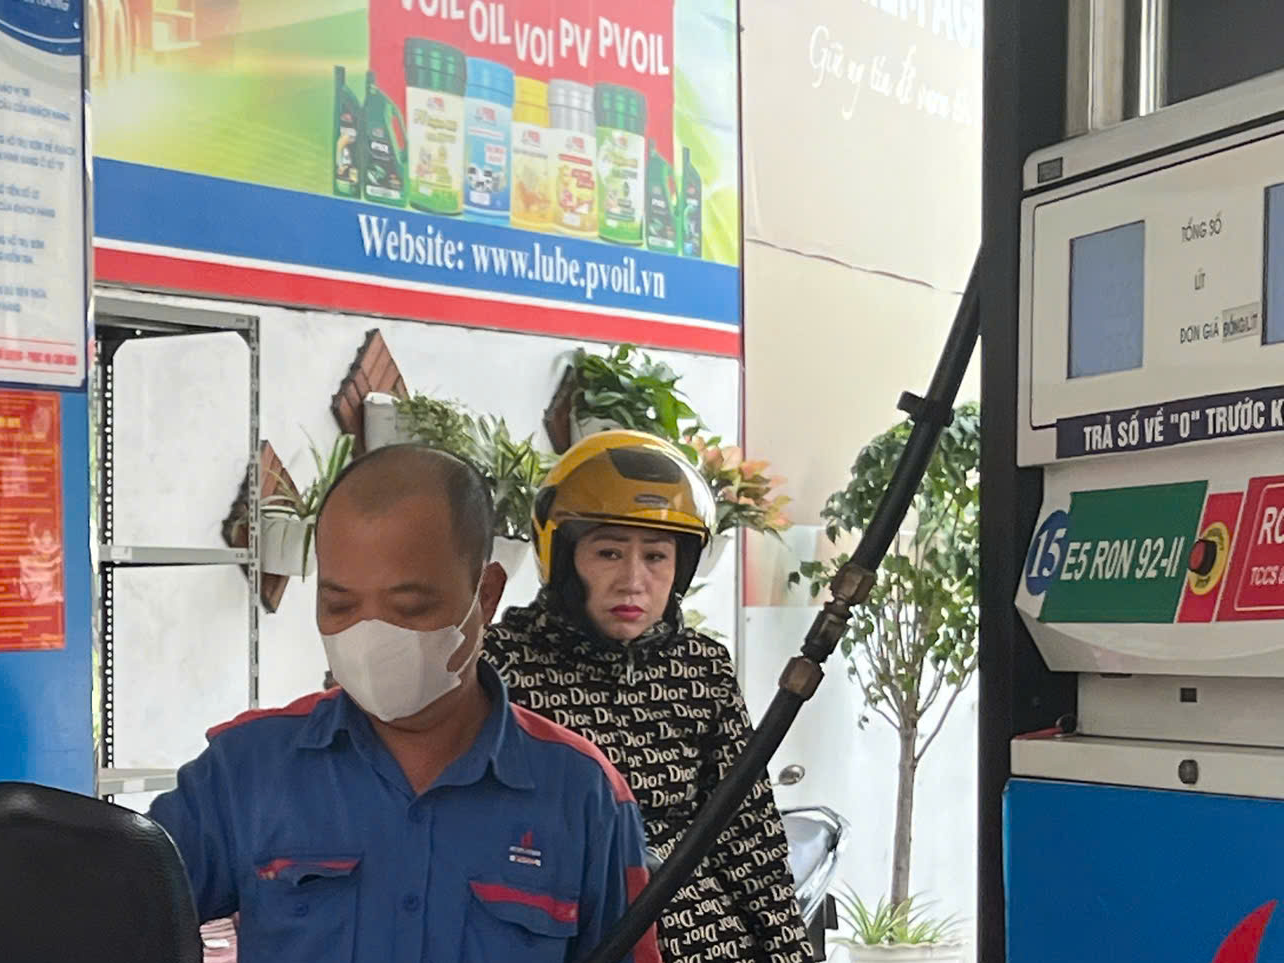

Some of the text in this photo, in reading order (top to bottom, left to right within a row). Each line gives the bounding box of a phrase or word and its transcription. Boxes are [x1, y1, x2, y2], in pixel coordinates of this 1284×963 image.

[469, 0, 512, 44] OIL
[514, 20, 554, 67] VOI
[559, 17, 591, 68] PV
[597, 16, 670, 75] PVOIL
[357, 213, 666, 299] Website: www.lube.pvoil.vn
[1202, 316, 1220, 340] GIÁ
[1083, 415, 1113, 452] TRẢ
[1117, 409, 1140, 448] SỐ
[1144, 407, 1165, 443] VỀ
[1205, 397, 1266, 435] TRƯỚC
[1027, 528, 1068, 579] 15
[1060, 541, 1087, 581] E5
[1089, 538, 1136, 580] RON
[688, 639, 725, 657] Dior
[508, 668, 584, 688] Dior Dior
[670, 659, 708, 679] Dior
[529, 690, 567, 709] Dior
[569, 687, 610, 705] Dior
[650, 683, 688, 701] Dior
[554, 703, 712, 727] Dior Dior Dior Dior
[581, 728, 619, 745] Dior
[619, 729, 655, 746] Dior
[642, 747, 680, 764] Dior
[630, 770, 667, 789] Dior
[651, 789, 685, 808] Dior
[728, 832, 762, 856] Dior
[751, 842, 788, 866] Dior
[742, 868, 782, 895] Dior
[682, 924, 718, 944] Dior
[704, 940, 739, 960] Dior
